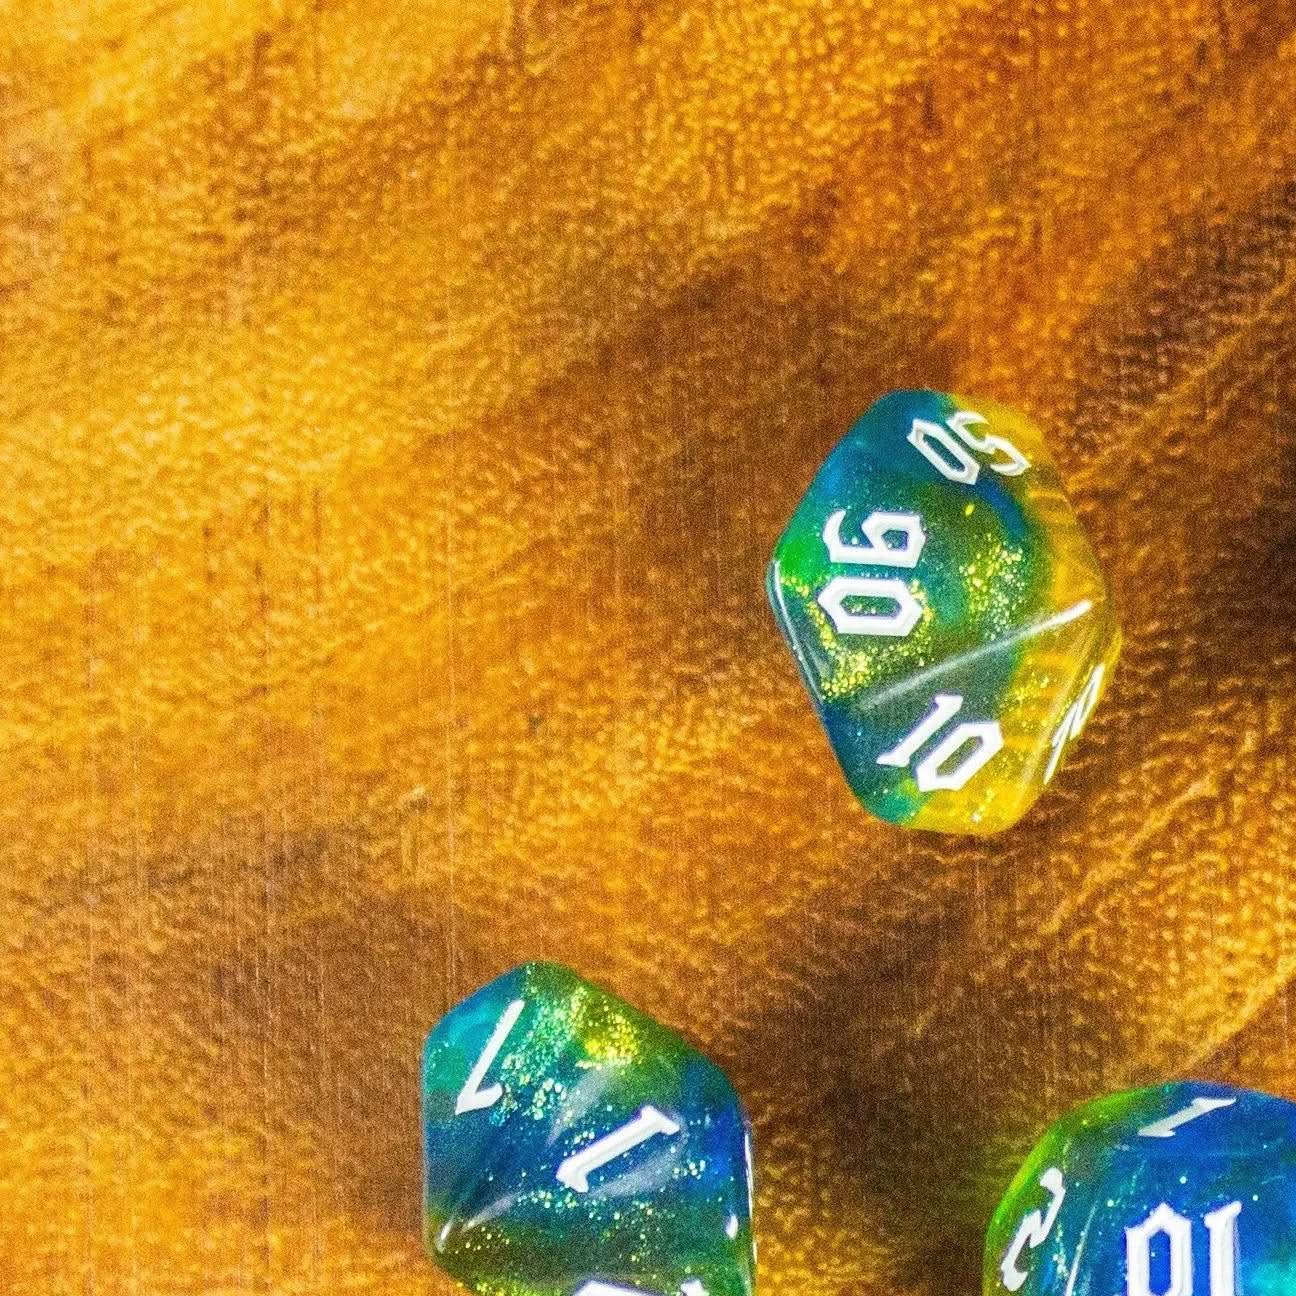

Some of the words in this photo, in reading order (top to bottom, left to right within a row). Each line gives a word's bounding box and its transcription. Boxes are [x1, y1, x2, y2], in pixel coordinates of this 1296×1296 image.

[907, 411, 1033, 486] 50
[875, 694, 1005, 792] 10
[555, 1105, 680, 1193] 1
[1138, 1098, 1237, 1137] 1
